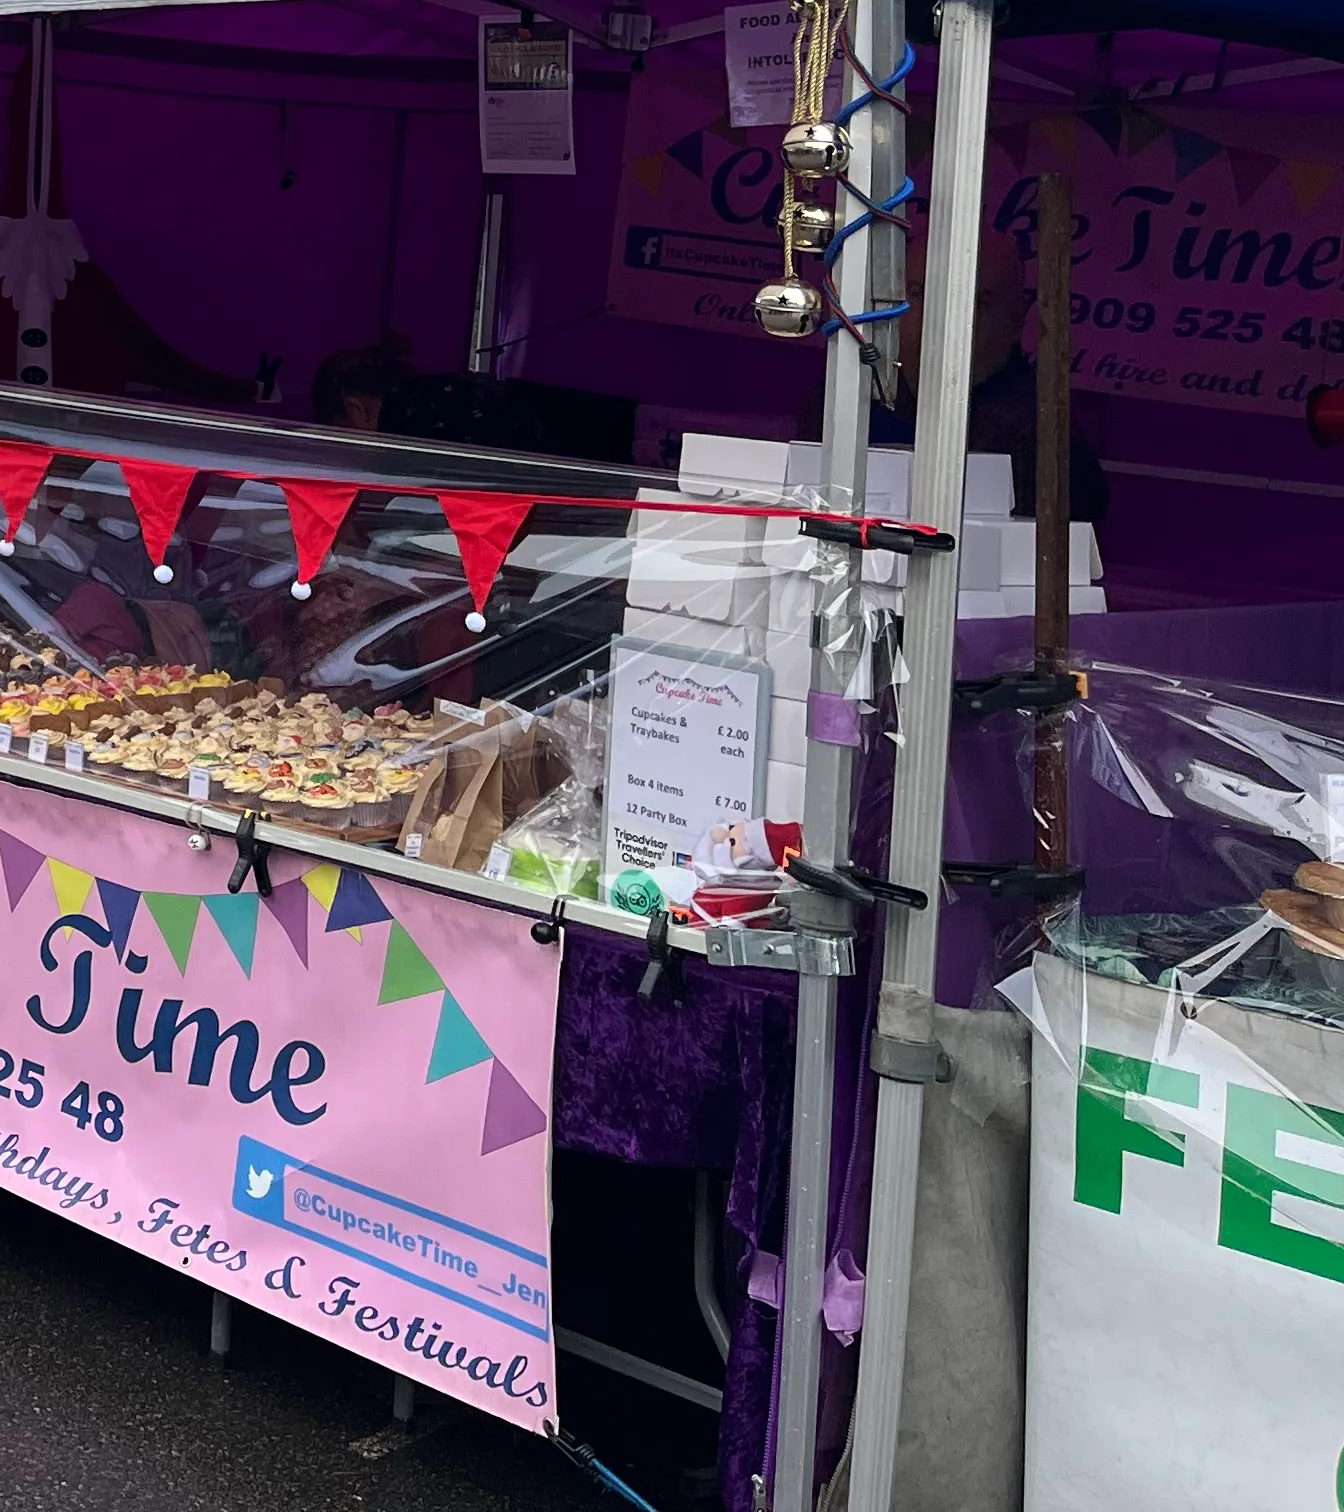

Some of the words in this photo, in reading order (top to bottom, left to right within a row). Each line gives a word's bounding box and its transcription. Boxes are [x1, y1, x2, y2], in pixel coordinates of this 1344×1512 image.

[740, 14, 781, 29] FOOD
[1173, 306, 1266, 343] 525
[1094, 352, 1167, 384] hire
[1180, 370, 1263, 397] and
[656, 682, 695, 701] Cupcake
[631, 706, 676, 727] Cupcakes
[680, 717, 687, 727] &
[630, 723, 680, 743] Traybakes
[727, 727, 749, 741] 2.00
[720, 745, 744, 758] each
[628, 774, 645, 787] Box
[648, 779, 654, 789] 4
[657, 781, 684, 797] items
[627, 802, 638, 815] 12
[641, 806, 666, 823] Party
[669, 813, 687, 827] Box
[725, 797, 747, 812] 7.00
[614, 827, 668, 850] Tripadvisor
[622, 852, 656, 869] Choice
[26, 914, 327, 1126] Time
[61, 1080, 124, 1142] 48
[138, 1197, 247, 1272] Fetes
[264, 1256, 306, 1299] &
[318, 1276, 548, 1408] Festivals
